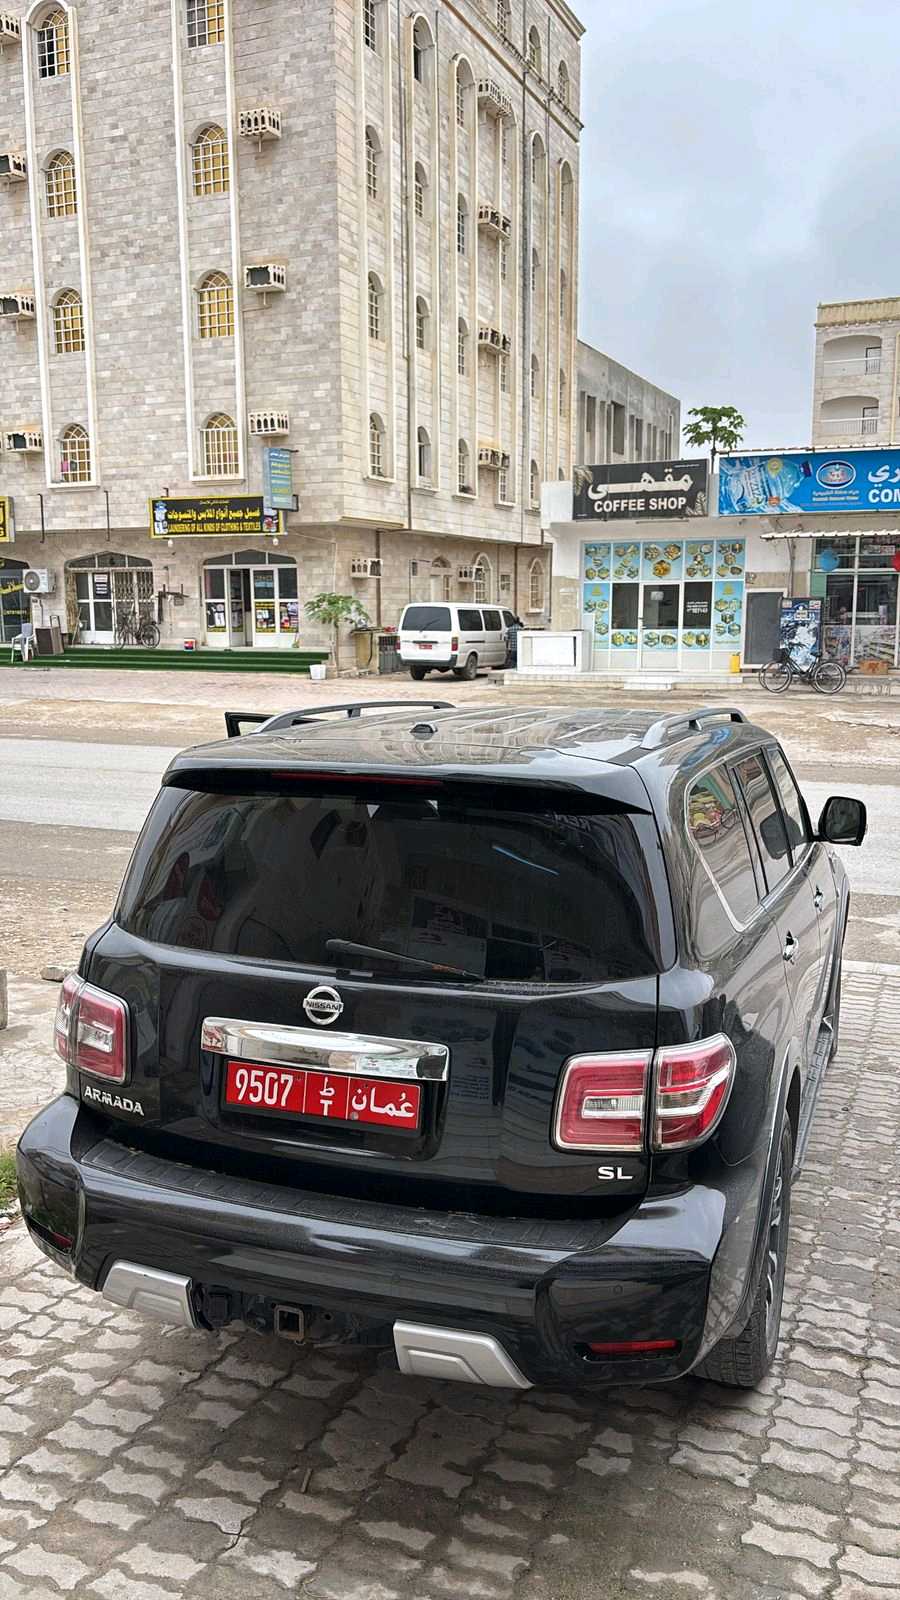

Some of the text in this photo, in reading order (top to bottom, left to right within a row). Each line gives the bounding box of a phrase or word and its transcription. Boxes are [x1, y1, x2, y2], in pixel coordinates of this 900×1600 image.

[594, 496, 687, 513] COFFEE SHOP
[306, 1000, 340, 1011] NISSAN
[235, 1068, 294, 1107] 9507
[84, 1085, 145, 1117] ARMADA
[319, 1100, 333, 1116] T
[598, 1166, 633, 1180] SL
